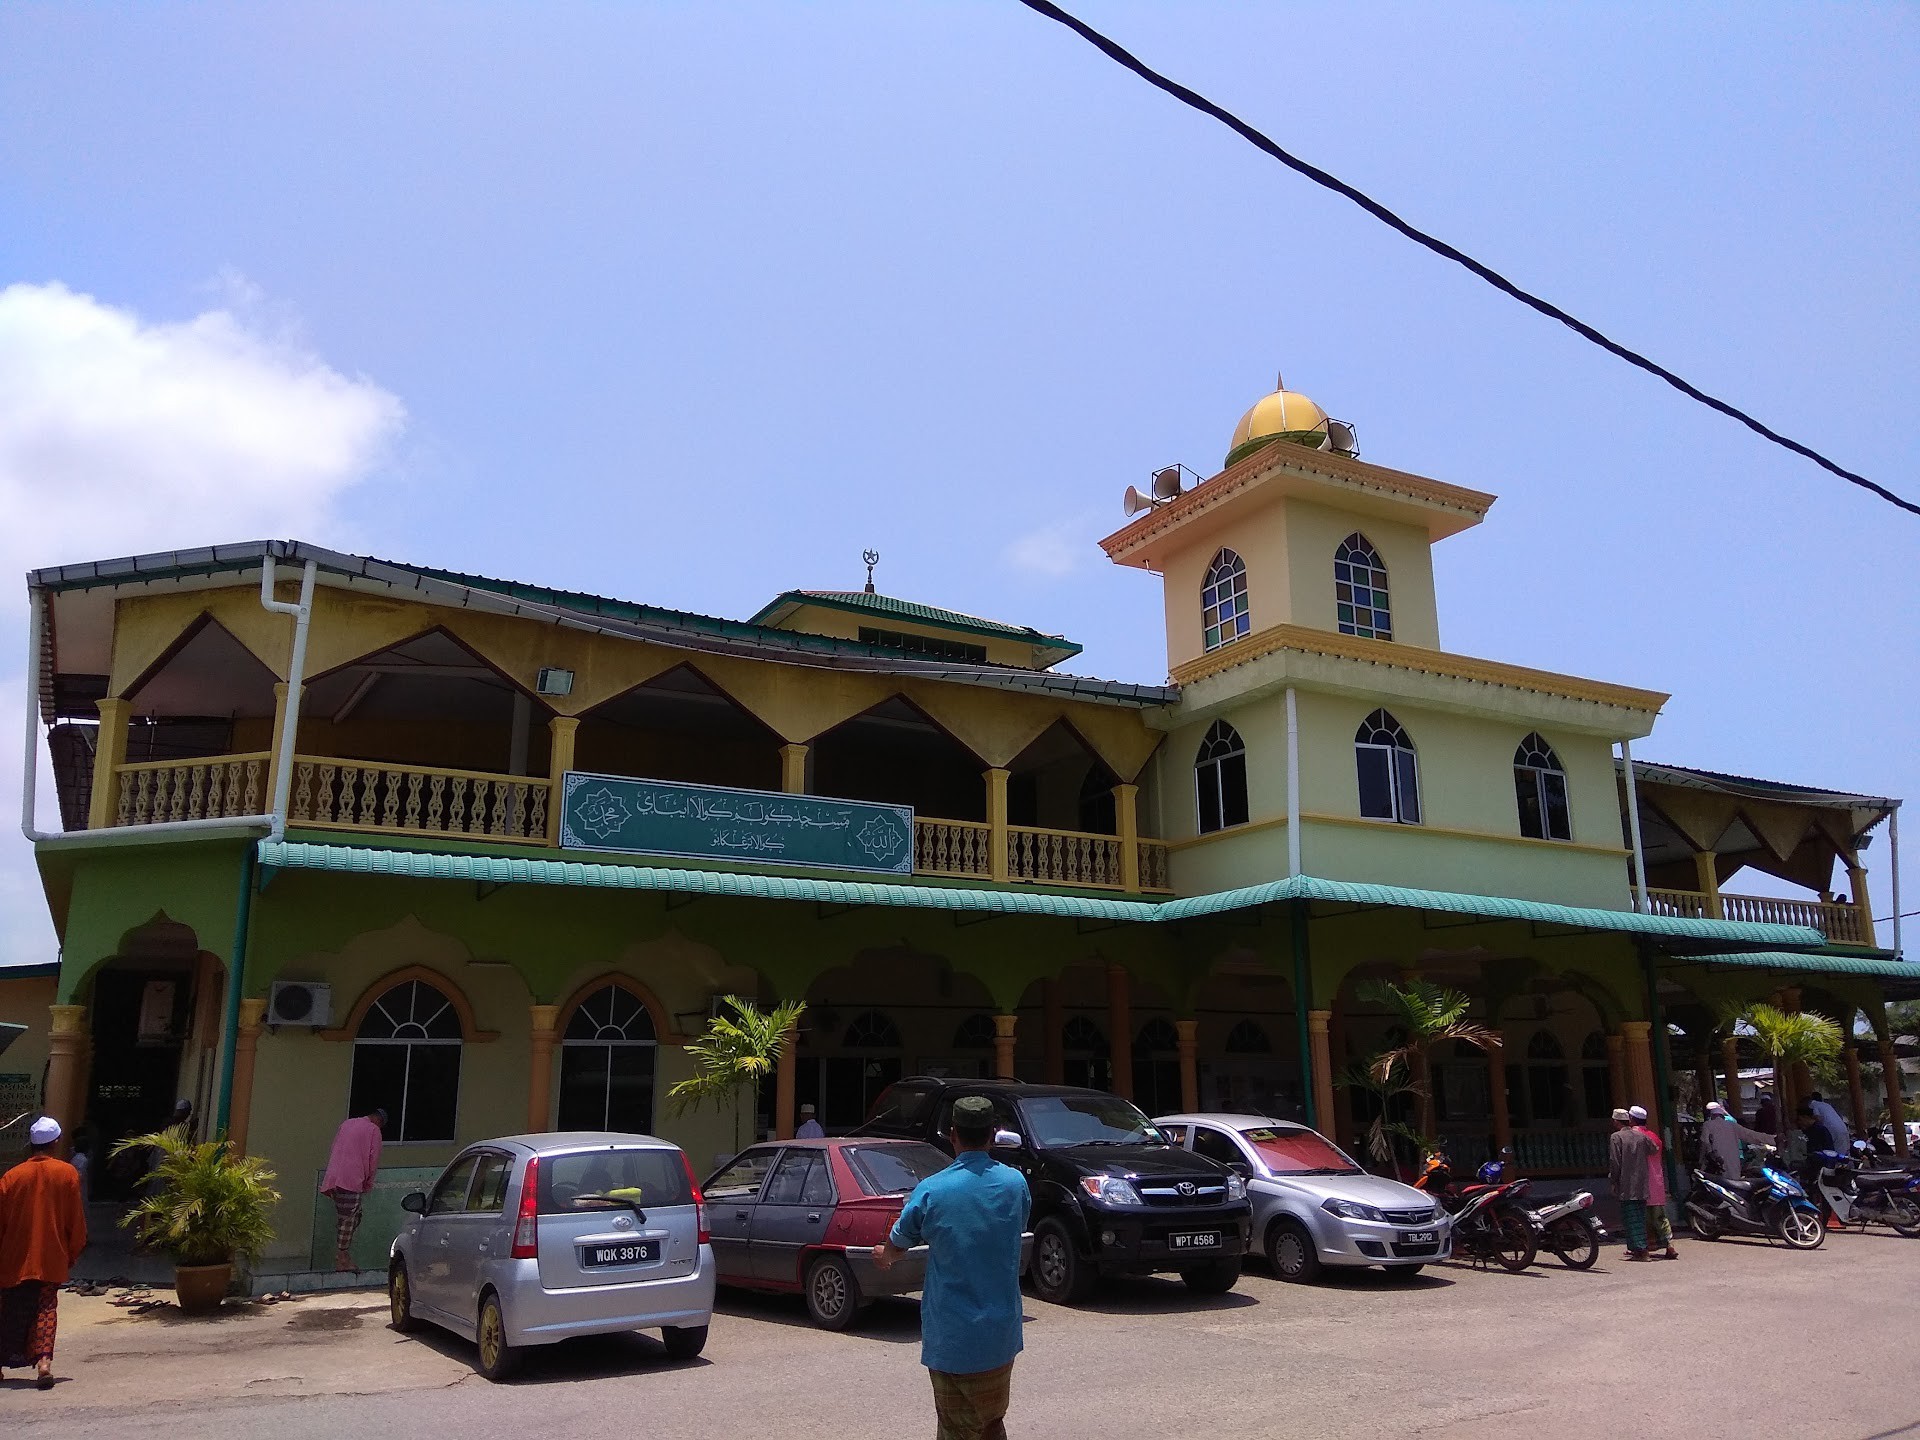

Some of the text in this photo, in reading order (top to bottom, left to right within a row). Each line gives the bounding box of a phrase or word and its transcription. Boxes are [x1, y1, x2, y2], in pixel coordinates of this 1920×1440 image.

[1175, 1235, 1214, 1247] WPT 4568
[596, 1246, 648, 1262] WQK 3876
